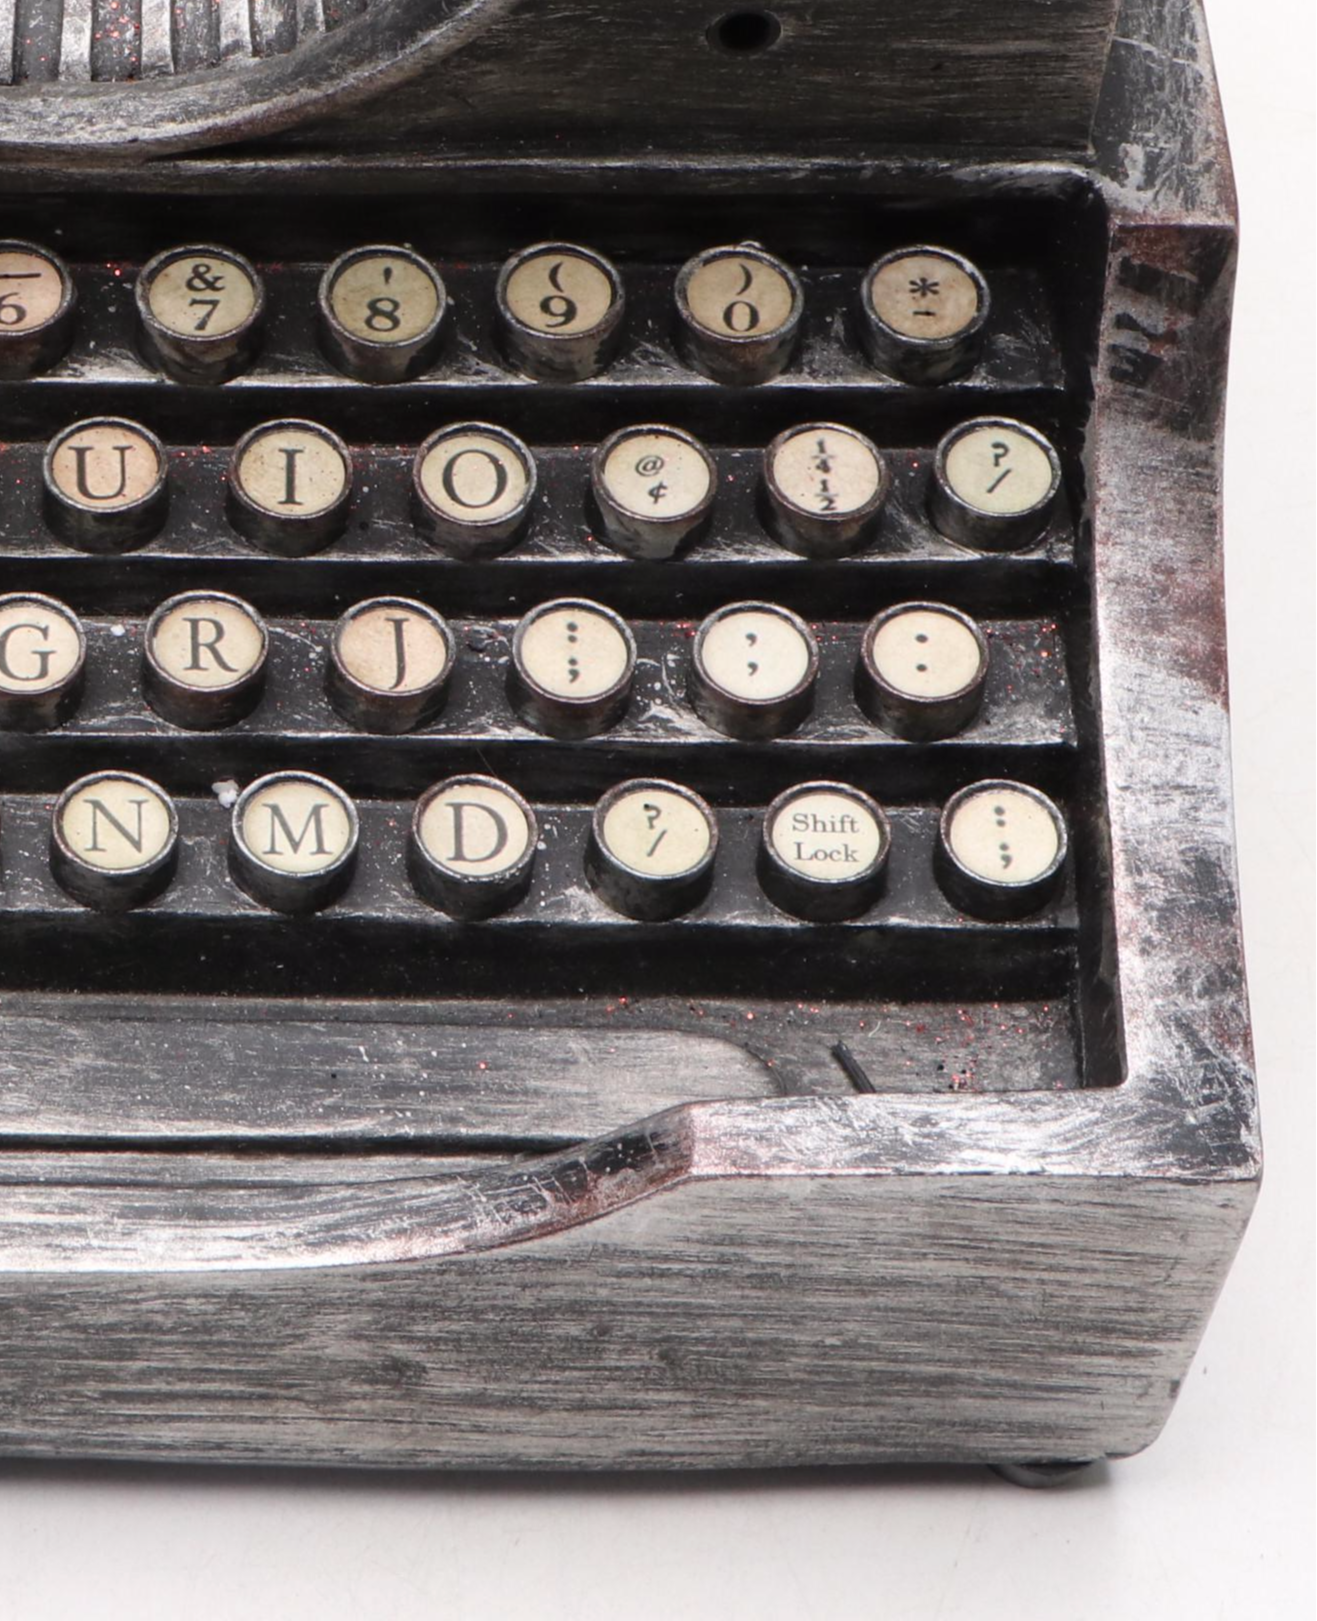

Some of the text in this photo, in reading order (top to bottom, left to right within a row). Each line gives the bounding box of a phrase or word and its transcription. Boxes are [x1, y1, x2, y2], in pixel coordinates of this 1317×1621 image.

[186, 264, 224, 292] &
[549, 262, 563, 292] (
[737, 264, 752, 295] )
[189, 298, 220, 331] 7
[365, 298, 400, 332] 8
[540, 295, 577, 328] 9
[723, 301, 759, 331] 0
[67, 446, 133, 499] U
[278, 449, 303, 505] I
[442, 449, 507, 508] O
[635, 456, 665, 477] @
[183, 618, 238, 672] R
[384, 618, 411, 689] J
[83, 799, 148, 853] N
[262, 803, 332, 855] M
[445, 803, 507, 863] D
[793, 813, 859, 833] Shift
[794, 842, 858, 862] Lock
